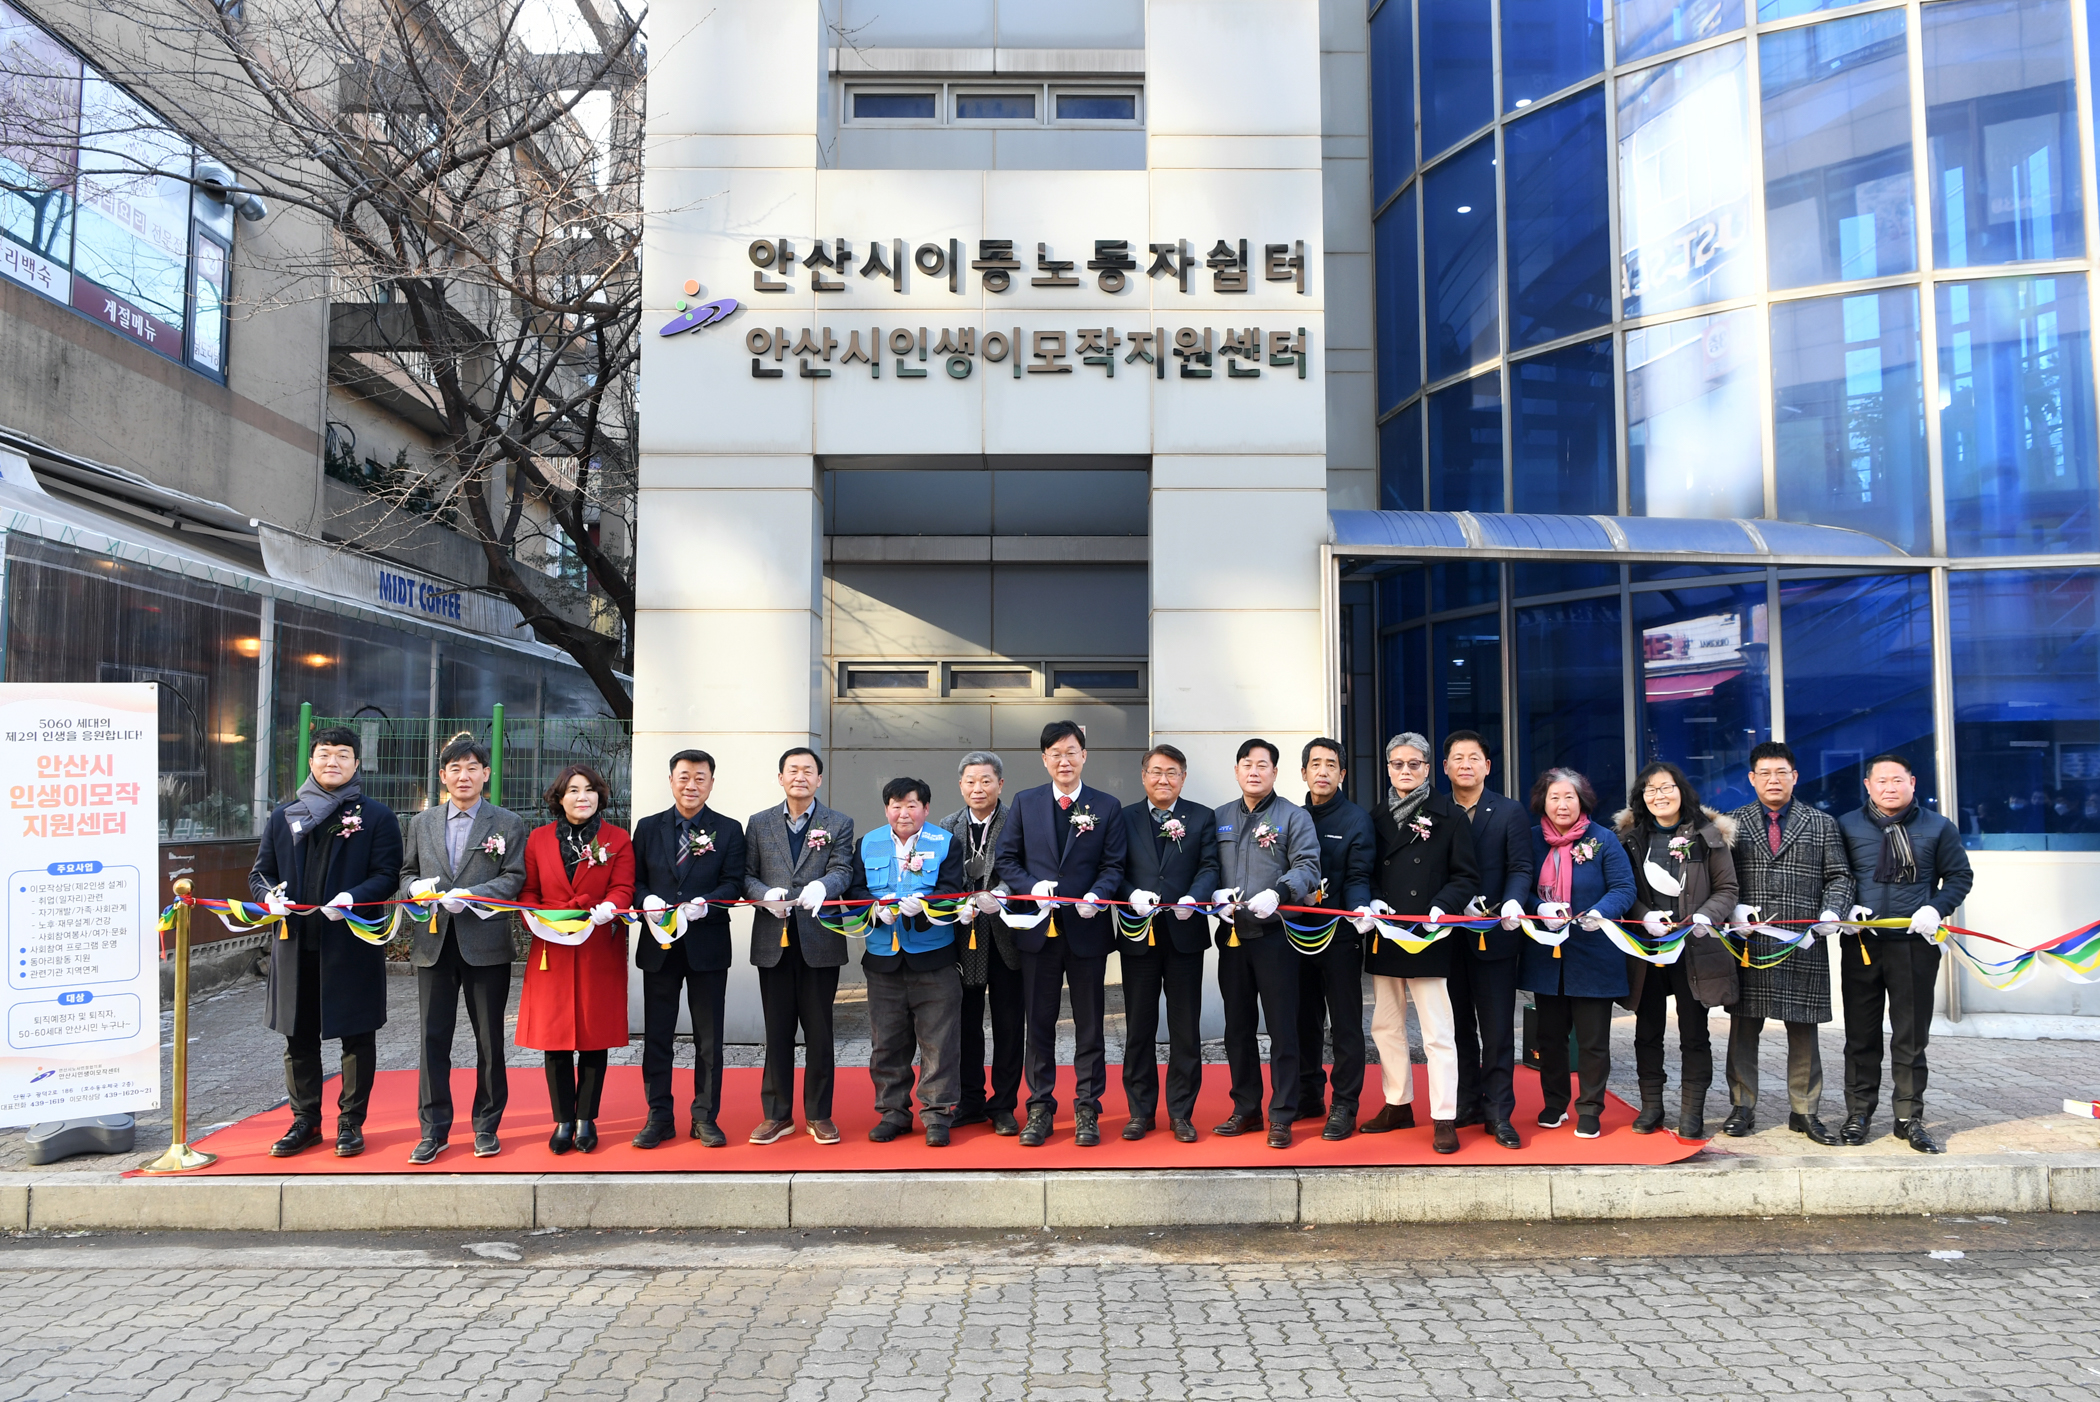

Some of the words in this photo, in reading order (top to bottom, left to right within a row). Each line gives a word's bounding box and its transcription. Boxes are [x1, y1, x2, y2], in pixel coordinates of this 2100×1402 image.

[747, 238, 1305, 293] 안산시이동노동자쉼터
[103, 297, 157, 342] 계절메뉴
[745, 326, 1306, 379] 안산시인생이모작지원센터
[379, 570, 415, 608] MIDT
[419, 582, 461, 620] COFFEE
[39, 718, 72, 729] 5060
[76, 718, 111, 729] 세대의
[5, 731, 38, 742] 제2의
[42, 730, 78, 742] 인생을
[82, 730, 143, 741] 응원합니다!
[37, 753, 114, 779] 안산시
[9, 782, 141, 809] 인생이모작
[22, 811, 126, 838] 지원센터
[56, 862, 94, 873] 주요사업
[108, 879, 128, 889] 설계)
[38, 893, 104, 905] 취업(일자리)관련
[30, 943, 63, 954] 사회참여
[66, 941, 99, 952] 프로그램
[101, 940, 118, 949] 운영
[30, 955, 72, 967] 동아리활동
[74, 953, 91, 963] 지원
[30, 968, 63, 979] 관련기관
[66, 965, 99, 976] 지역연계
[66, 993, 85, 1003] 대상
[33, 1013, 76, 1025] 퇴직예정자
[78, 1012, 86, 1021] 및
[18, 1026, 63, 1038] 50-60세대
[65, 1023, 98, 1034] 안산시민
[0, 1102, 27, 1111] 대표전화
[30, 1097, 65, 1107] 439-1619
[69, 1093, 101, 1103] 이모작상담
[104, 1087, 152, 1099] 439-1620~21
